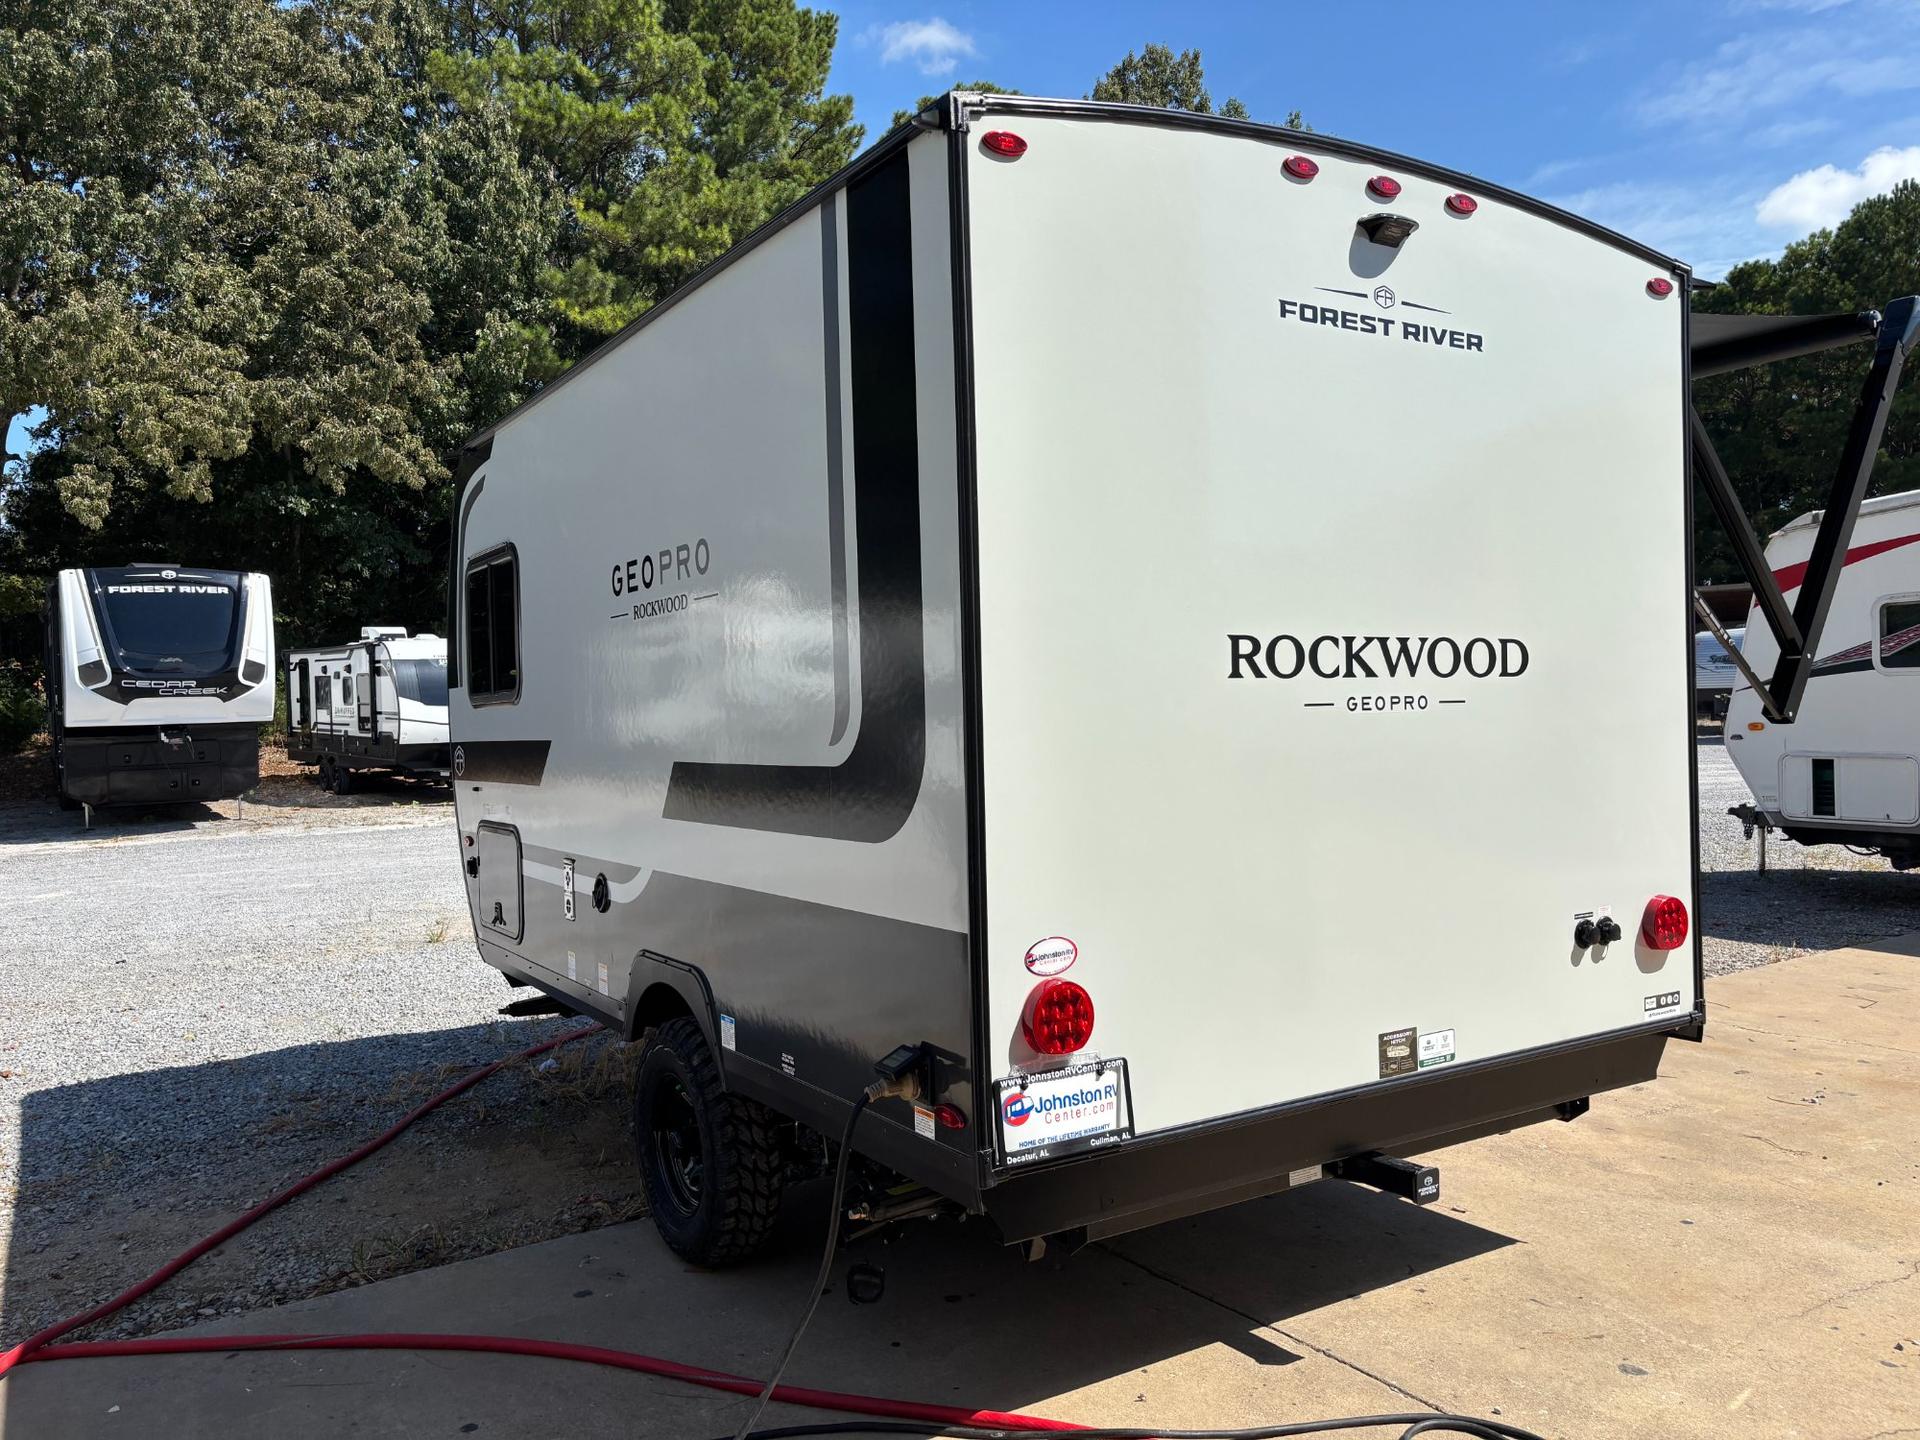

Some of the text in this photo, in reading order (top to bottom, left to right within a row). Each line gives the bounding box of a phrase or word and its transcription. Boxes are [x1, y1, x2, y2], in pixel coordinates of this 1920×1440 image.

[1278, 299, 1484, 352] FOREST RIVER
[611, 537, 710, 597] GEOPRO
[108, 585, 229, 594] FOREST RIVER
[633, 593, 688, 621] ROCKWOOD
[1226, 634, 1530, 680] ROCKWOOD
[121, 680, 197, 688] CEDAR
[159, 687, 228, 696] CREEK
[1346, 695, 1428, 712] GEOPRO
[1037, 950, 1066, 961] Johnston
[1034, 1084, 1118, 1114] Johnston RV
[1044, 1101, 1114, 1125] Center.com
[1018, 1123, 1111, 1148] HOME OF THE LIFETIME WARRANTY
[1121, 1131, 1132, 1140] AL
[1006, 1149, 1050, 1165] Decatur, AL
